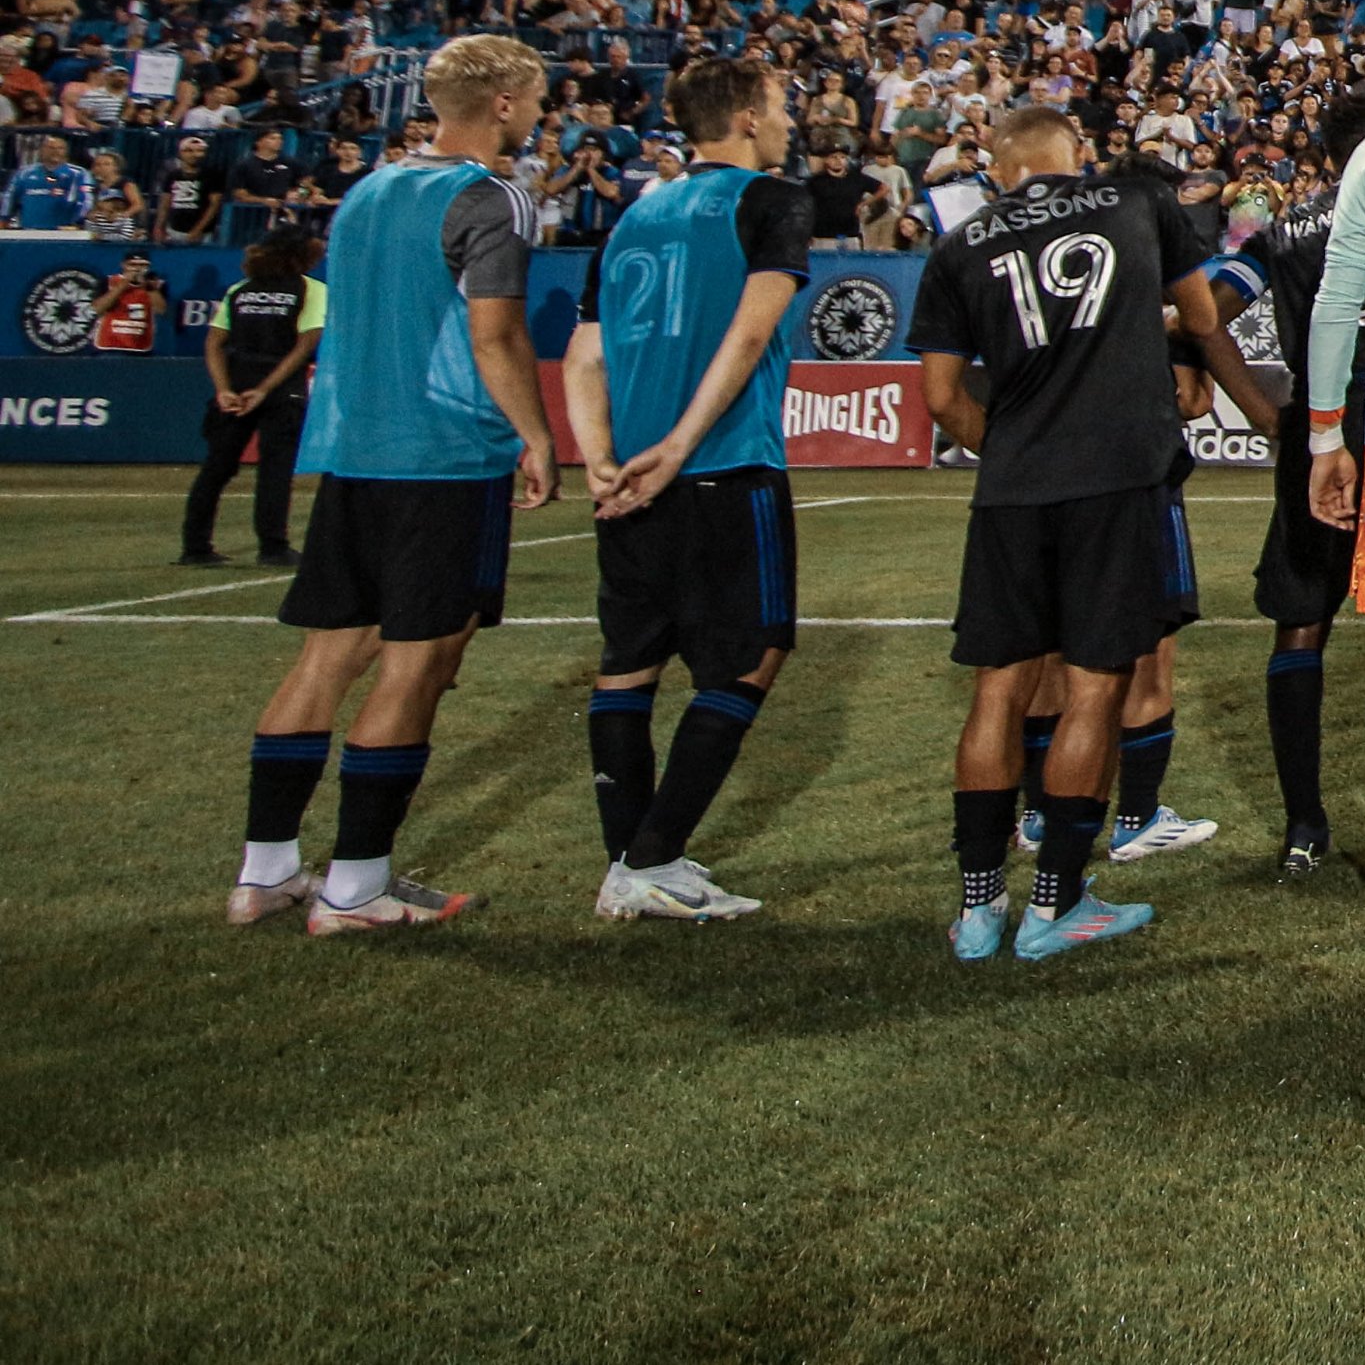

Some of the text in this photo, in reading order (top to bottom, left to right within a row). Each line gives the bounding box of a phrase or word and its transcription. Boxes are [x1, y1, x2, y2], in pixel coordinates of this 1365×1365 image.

[965, 186, 1119, 247] BASSONG
[608, 241, 688, 343] 21
[989, 232, 1118, 350] 19
[0, 397, 111, 426] NCES
